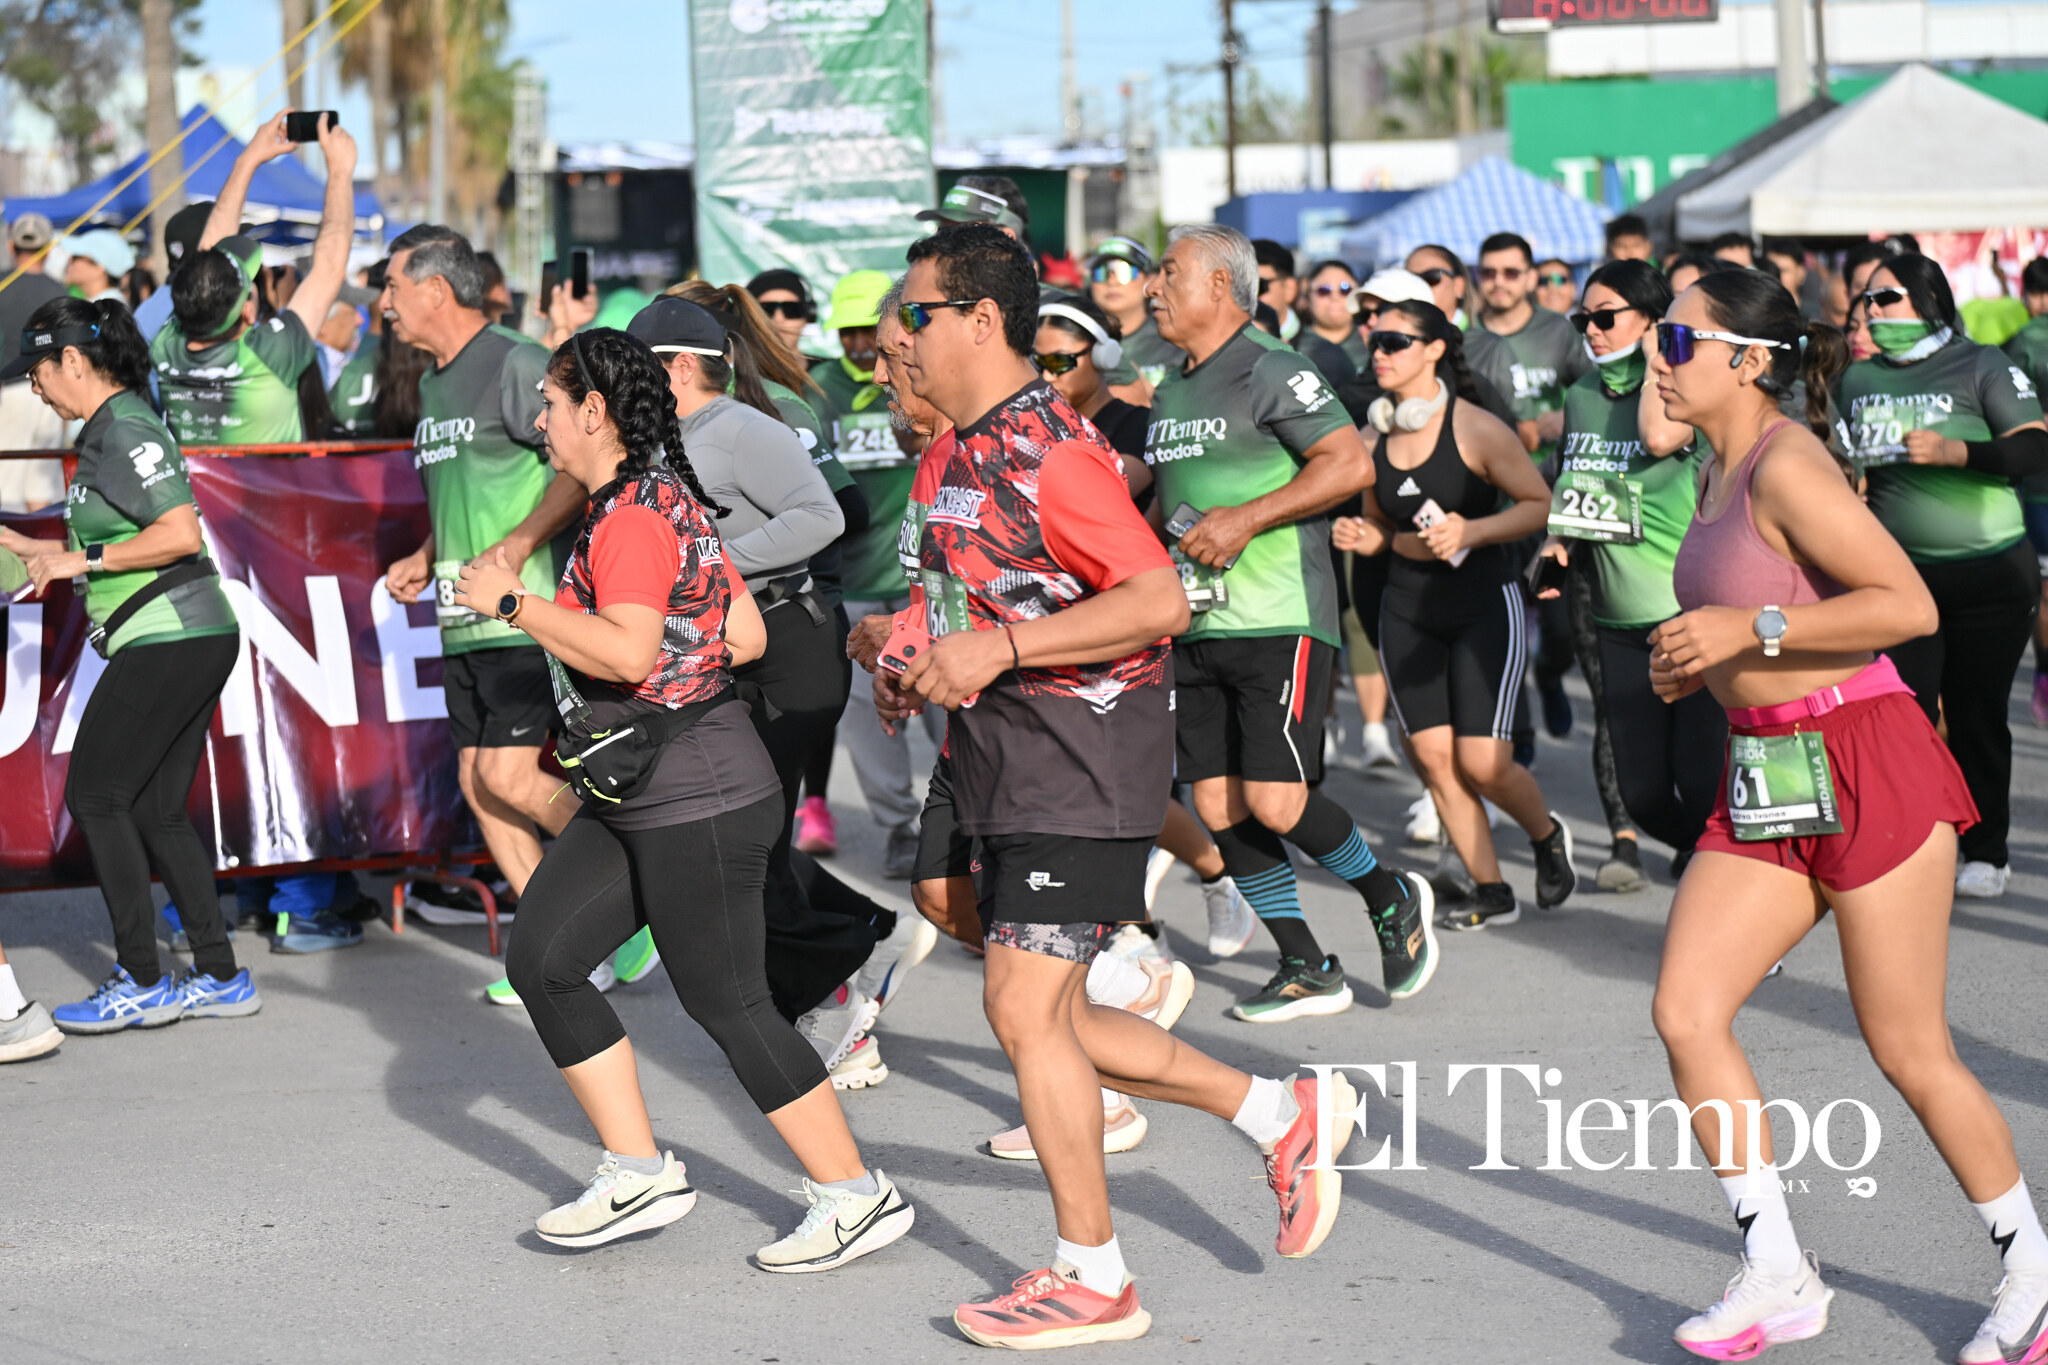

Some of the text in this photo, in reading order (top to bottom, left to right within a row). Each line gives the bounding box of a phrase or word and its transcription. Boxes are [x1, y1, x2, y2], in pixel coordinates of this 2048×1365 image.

[419, 416, 476, 445] Tiempo
[1157, 417, 1227, 442] Tiempo
[1858, 420, 1903, 448] 270
[421, 444, 458, 466] todos
[1155, 442, 1205, 463] todos
[1572, 457, 1629, 472] todos
[1561, 488, 1619, 521] 262
[1733, 766, 1771, 808] 61
[1812, 755, 1836, 823] MEDALLA
